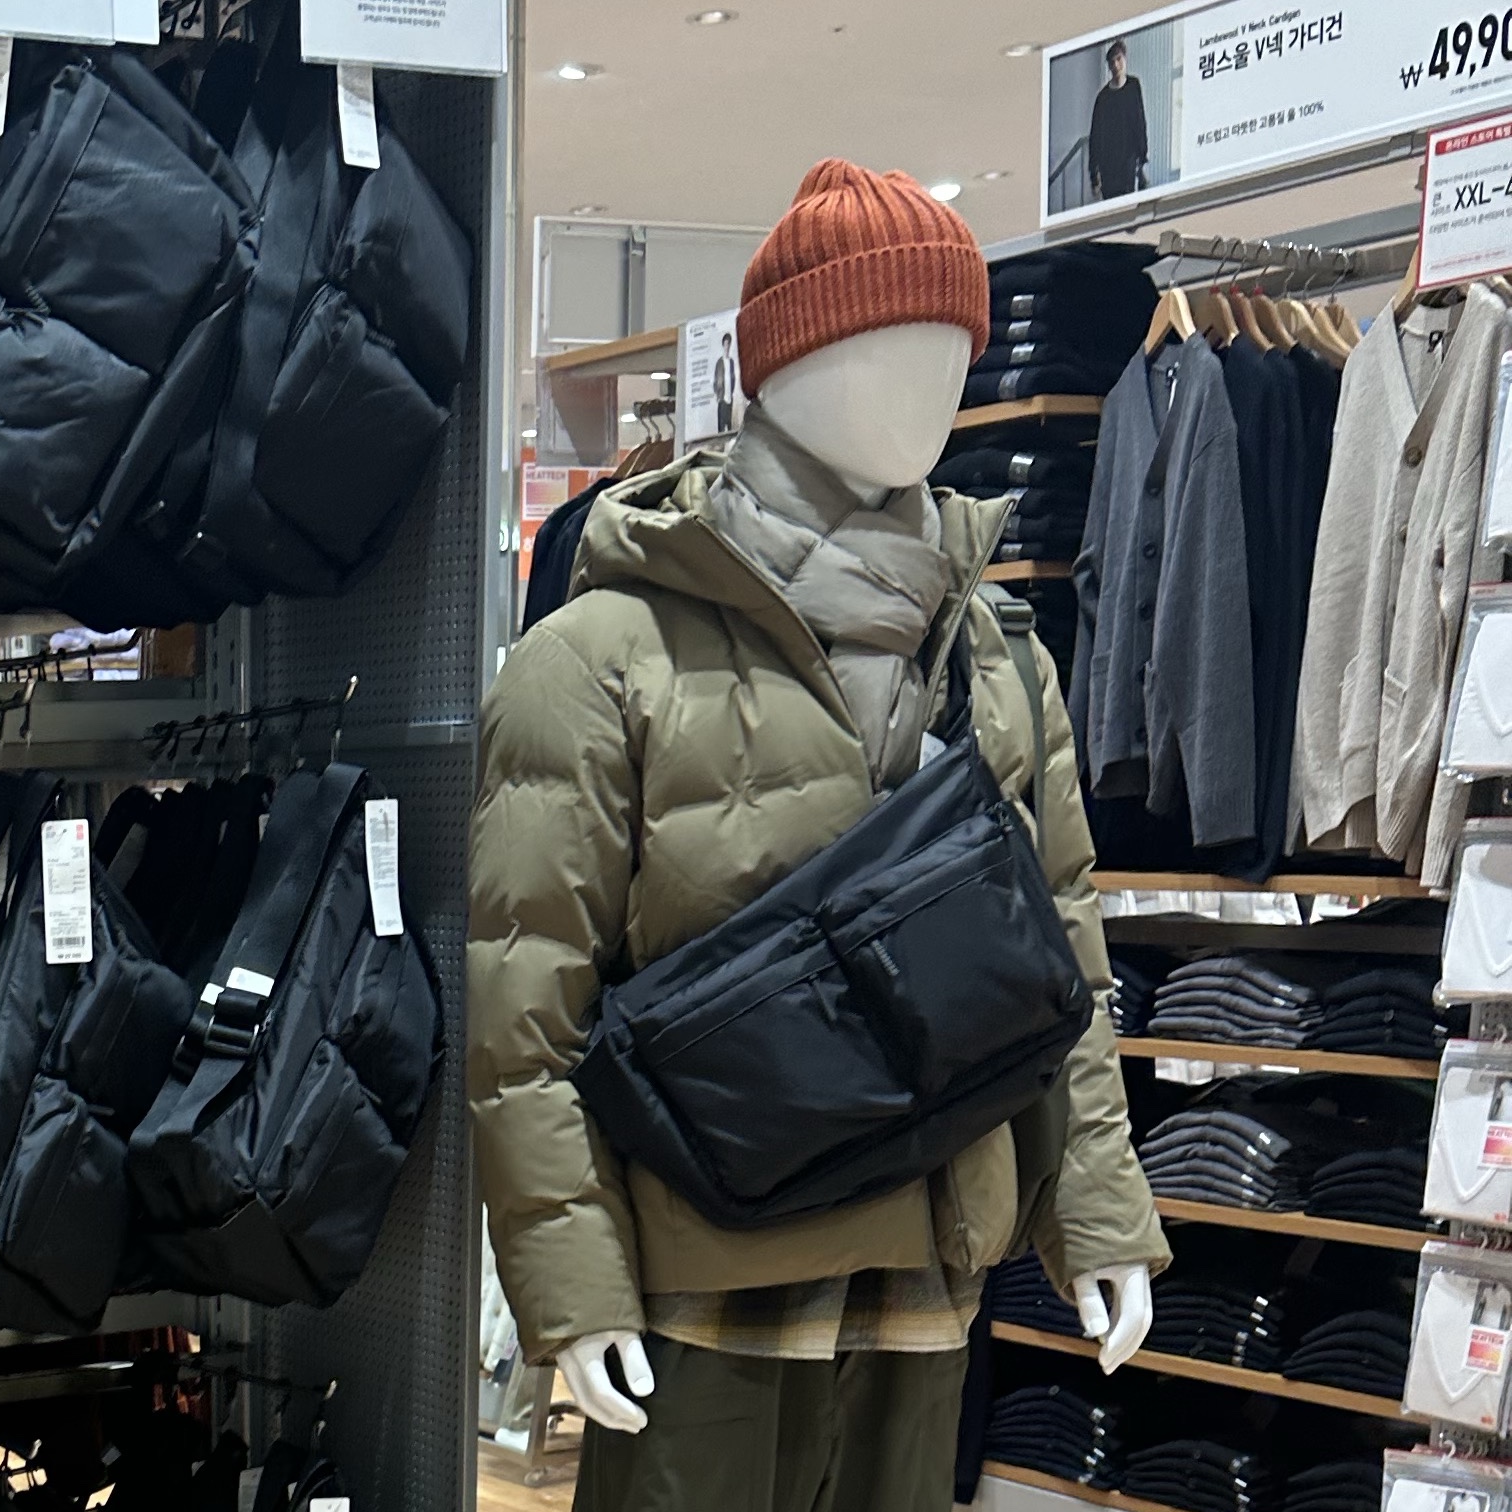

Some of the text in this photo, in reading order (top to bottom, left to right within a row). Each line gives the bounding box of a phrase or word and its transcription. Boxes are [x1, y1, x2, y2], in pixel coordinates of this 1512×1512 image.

[1199, 10, 1343, 81] 램스울 V넥 가디건
[1231, 118, 1258, 137] 따뜻한
[1299, 100, 1325, 118] 100%
